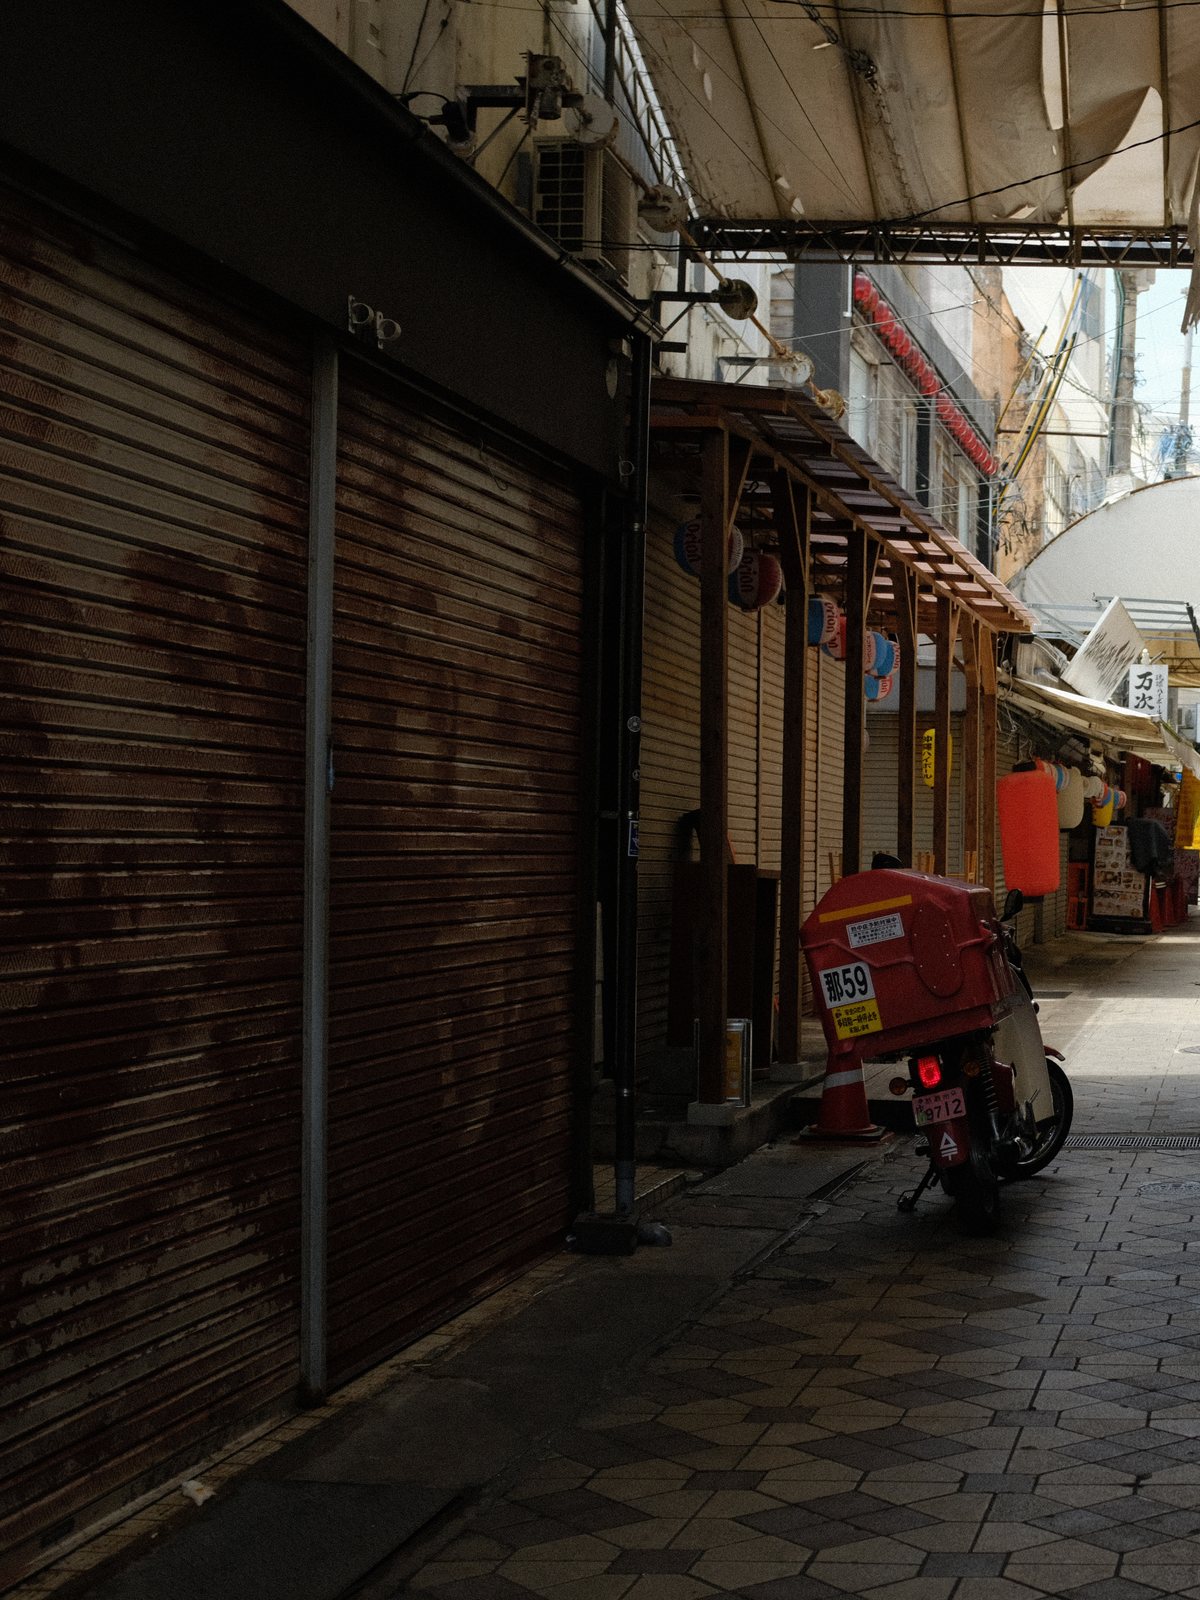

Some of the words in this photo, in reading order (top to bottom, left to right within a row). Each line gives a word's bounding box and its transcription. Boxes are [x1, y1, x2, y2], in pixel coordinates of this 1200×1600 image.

[1134, 671, 1155, 710] 万次
[823, 965, 868, 1002] 那59
[926, 1098, 963, 1120] 9712
